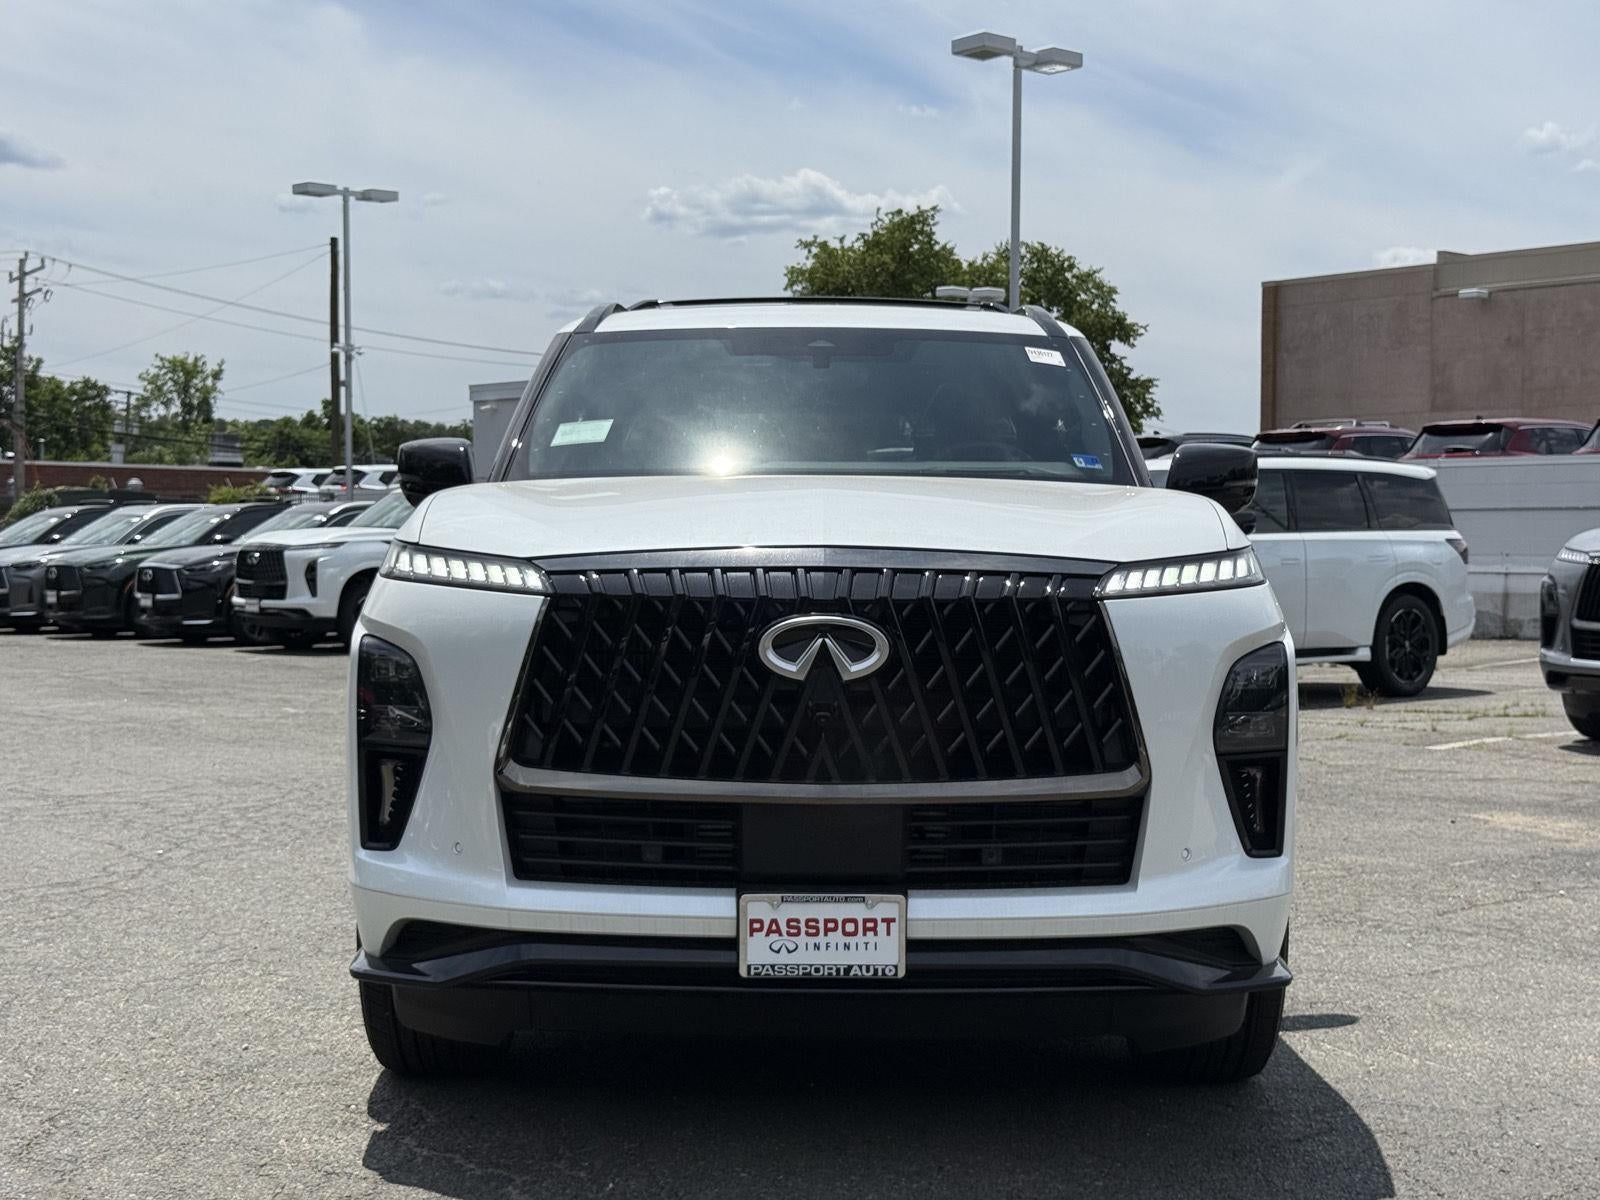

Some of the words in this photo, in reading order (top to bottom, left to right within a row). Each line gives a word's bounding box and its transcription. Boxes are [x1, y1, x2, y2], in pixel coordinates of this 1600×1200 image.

[749, 917, 896, 937] PASSPORT
[805, 941, 878, 951] INFINITI
[750, 964, 847, 977] PASSPORT
